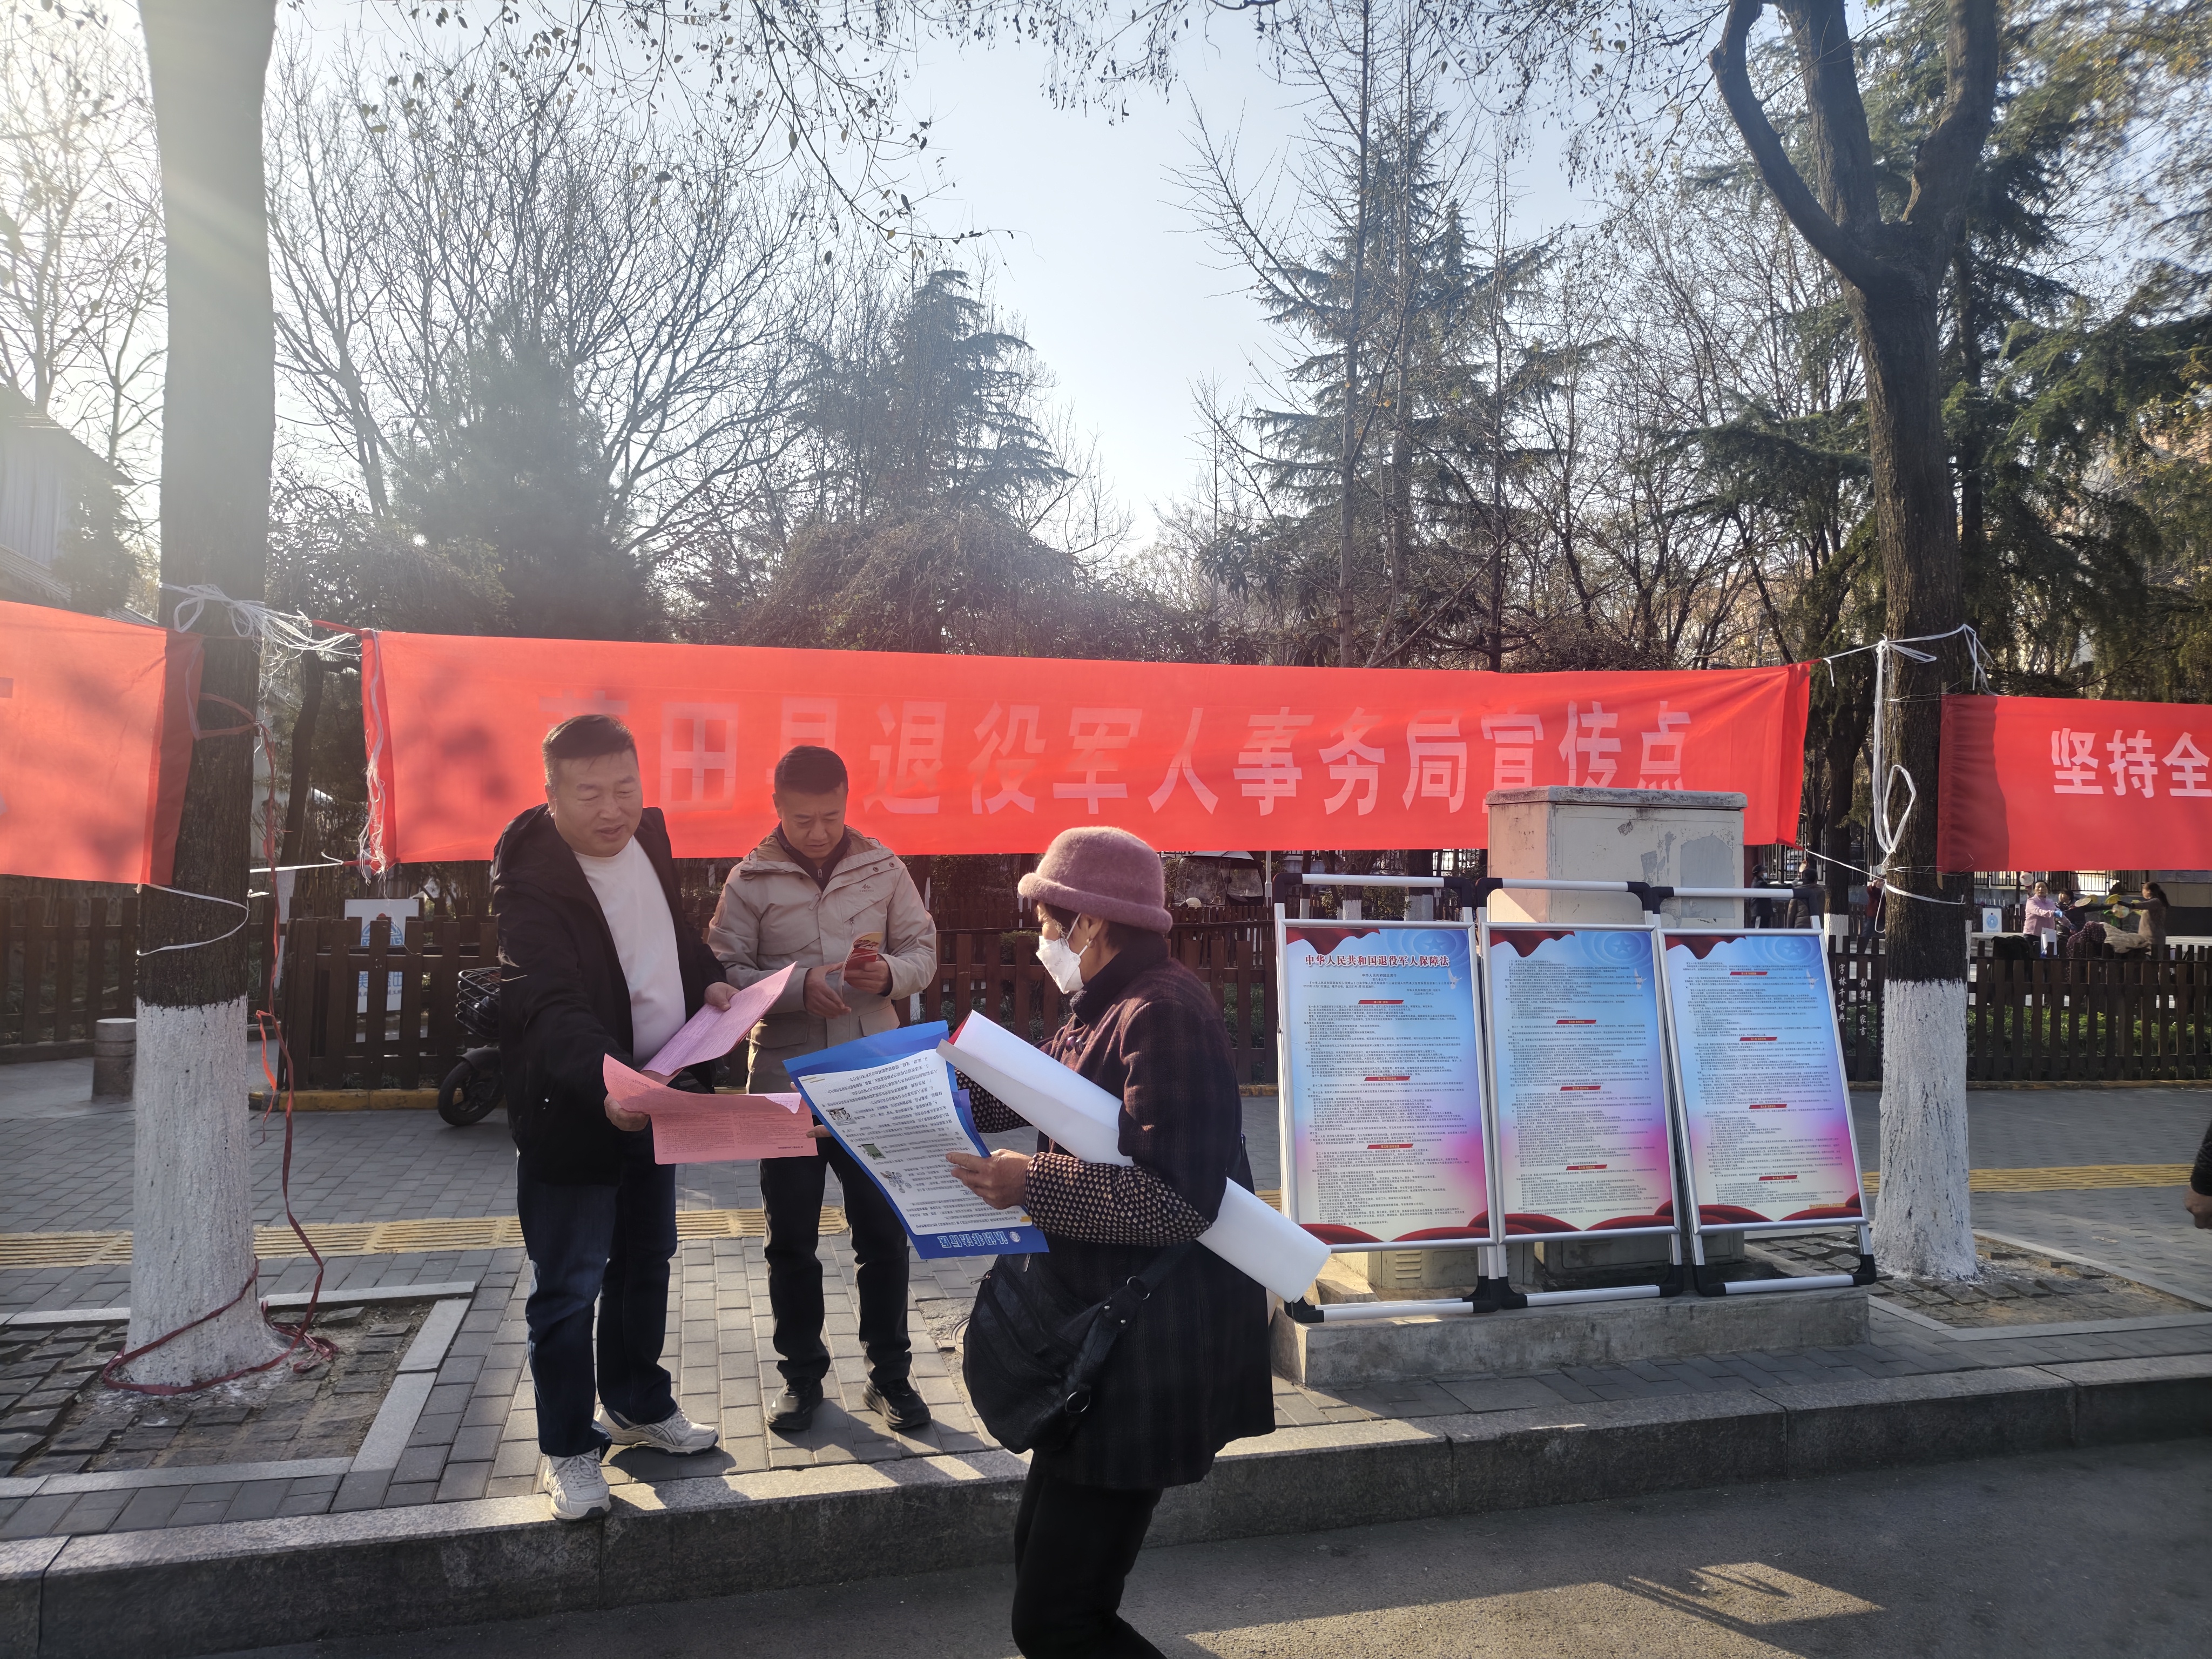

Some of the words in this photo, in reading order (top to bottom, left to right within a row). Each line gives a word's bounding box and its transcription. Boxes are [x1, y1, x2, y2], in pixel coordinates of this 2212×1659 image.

[538, 690, 1692, 815] 田退役军人事务局宣传点
[2051, 727, 2212, 798] 坚持全
[1305, 954, 1450, 967] 中华人民共和国退役军人保障法
[1837, 963, 1847, 1023] 字林千古典
[936, 1231, 1009, 1249] 认识非法行医
